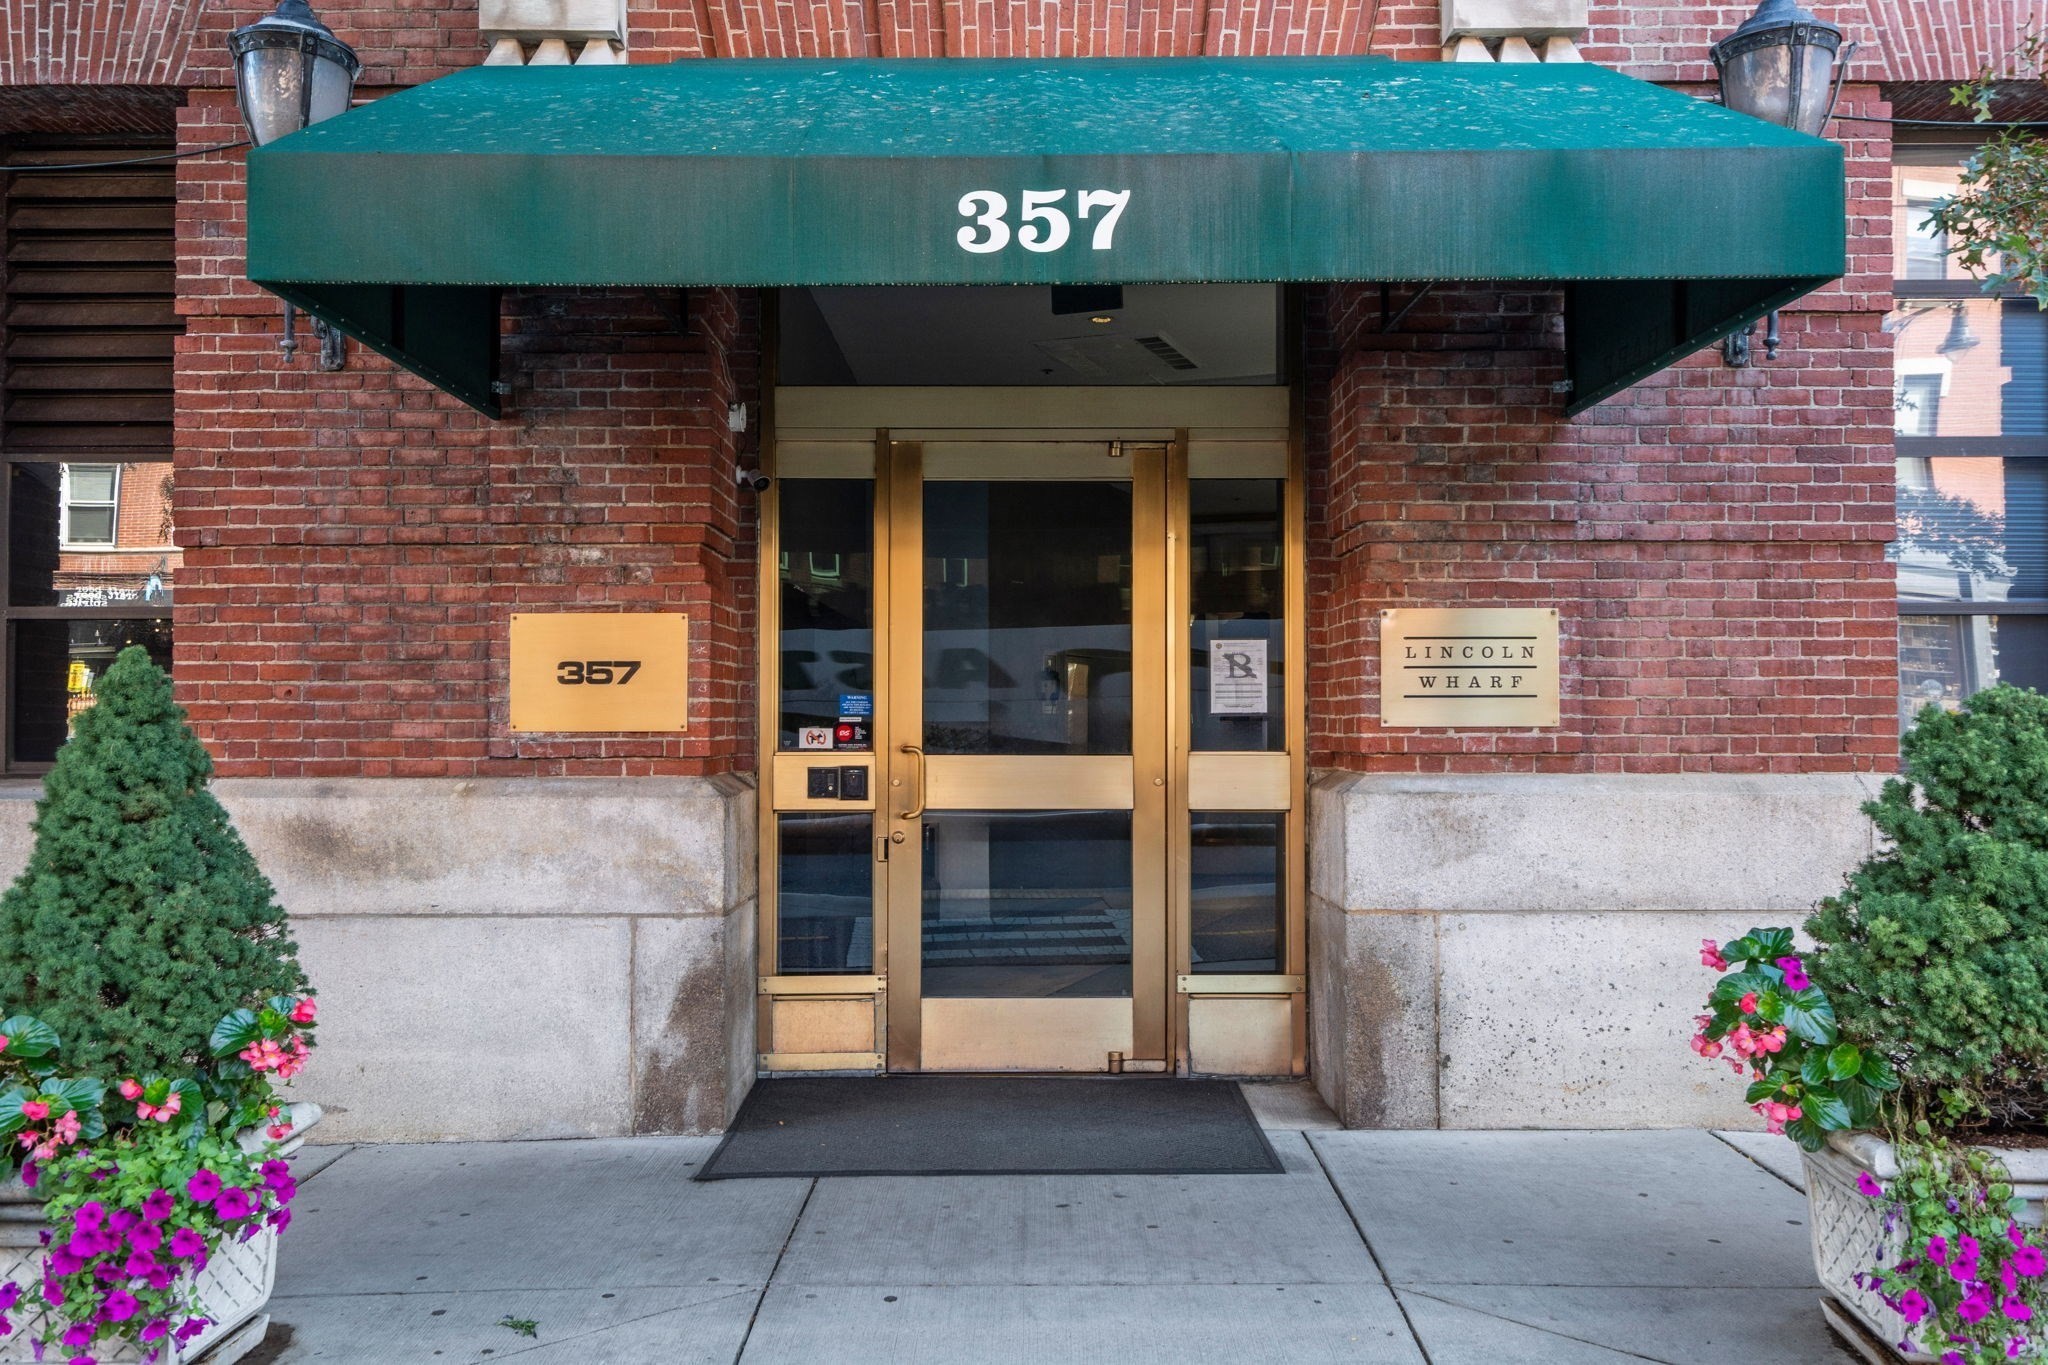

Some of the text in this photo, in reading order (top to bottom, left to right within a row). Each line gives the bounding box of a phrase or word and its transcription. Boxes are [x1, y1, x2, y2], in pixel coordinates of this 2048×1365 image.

[956, 188, 1131, 254] 357
[1405, 646, 1535, 659] LINCOLN
[556, 660, 642, 685] 357
[1418, 675, 1523, 688] WHARF
